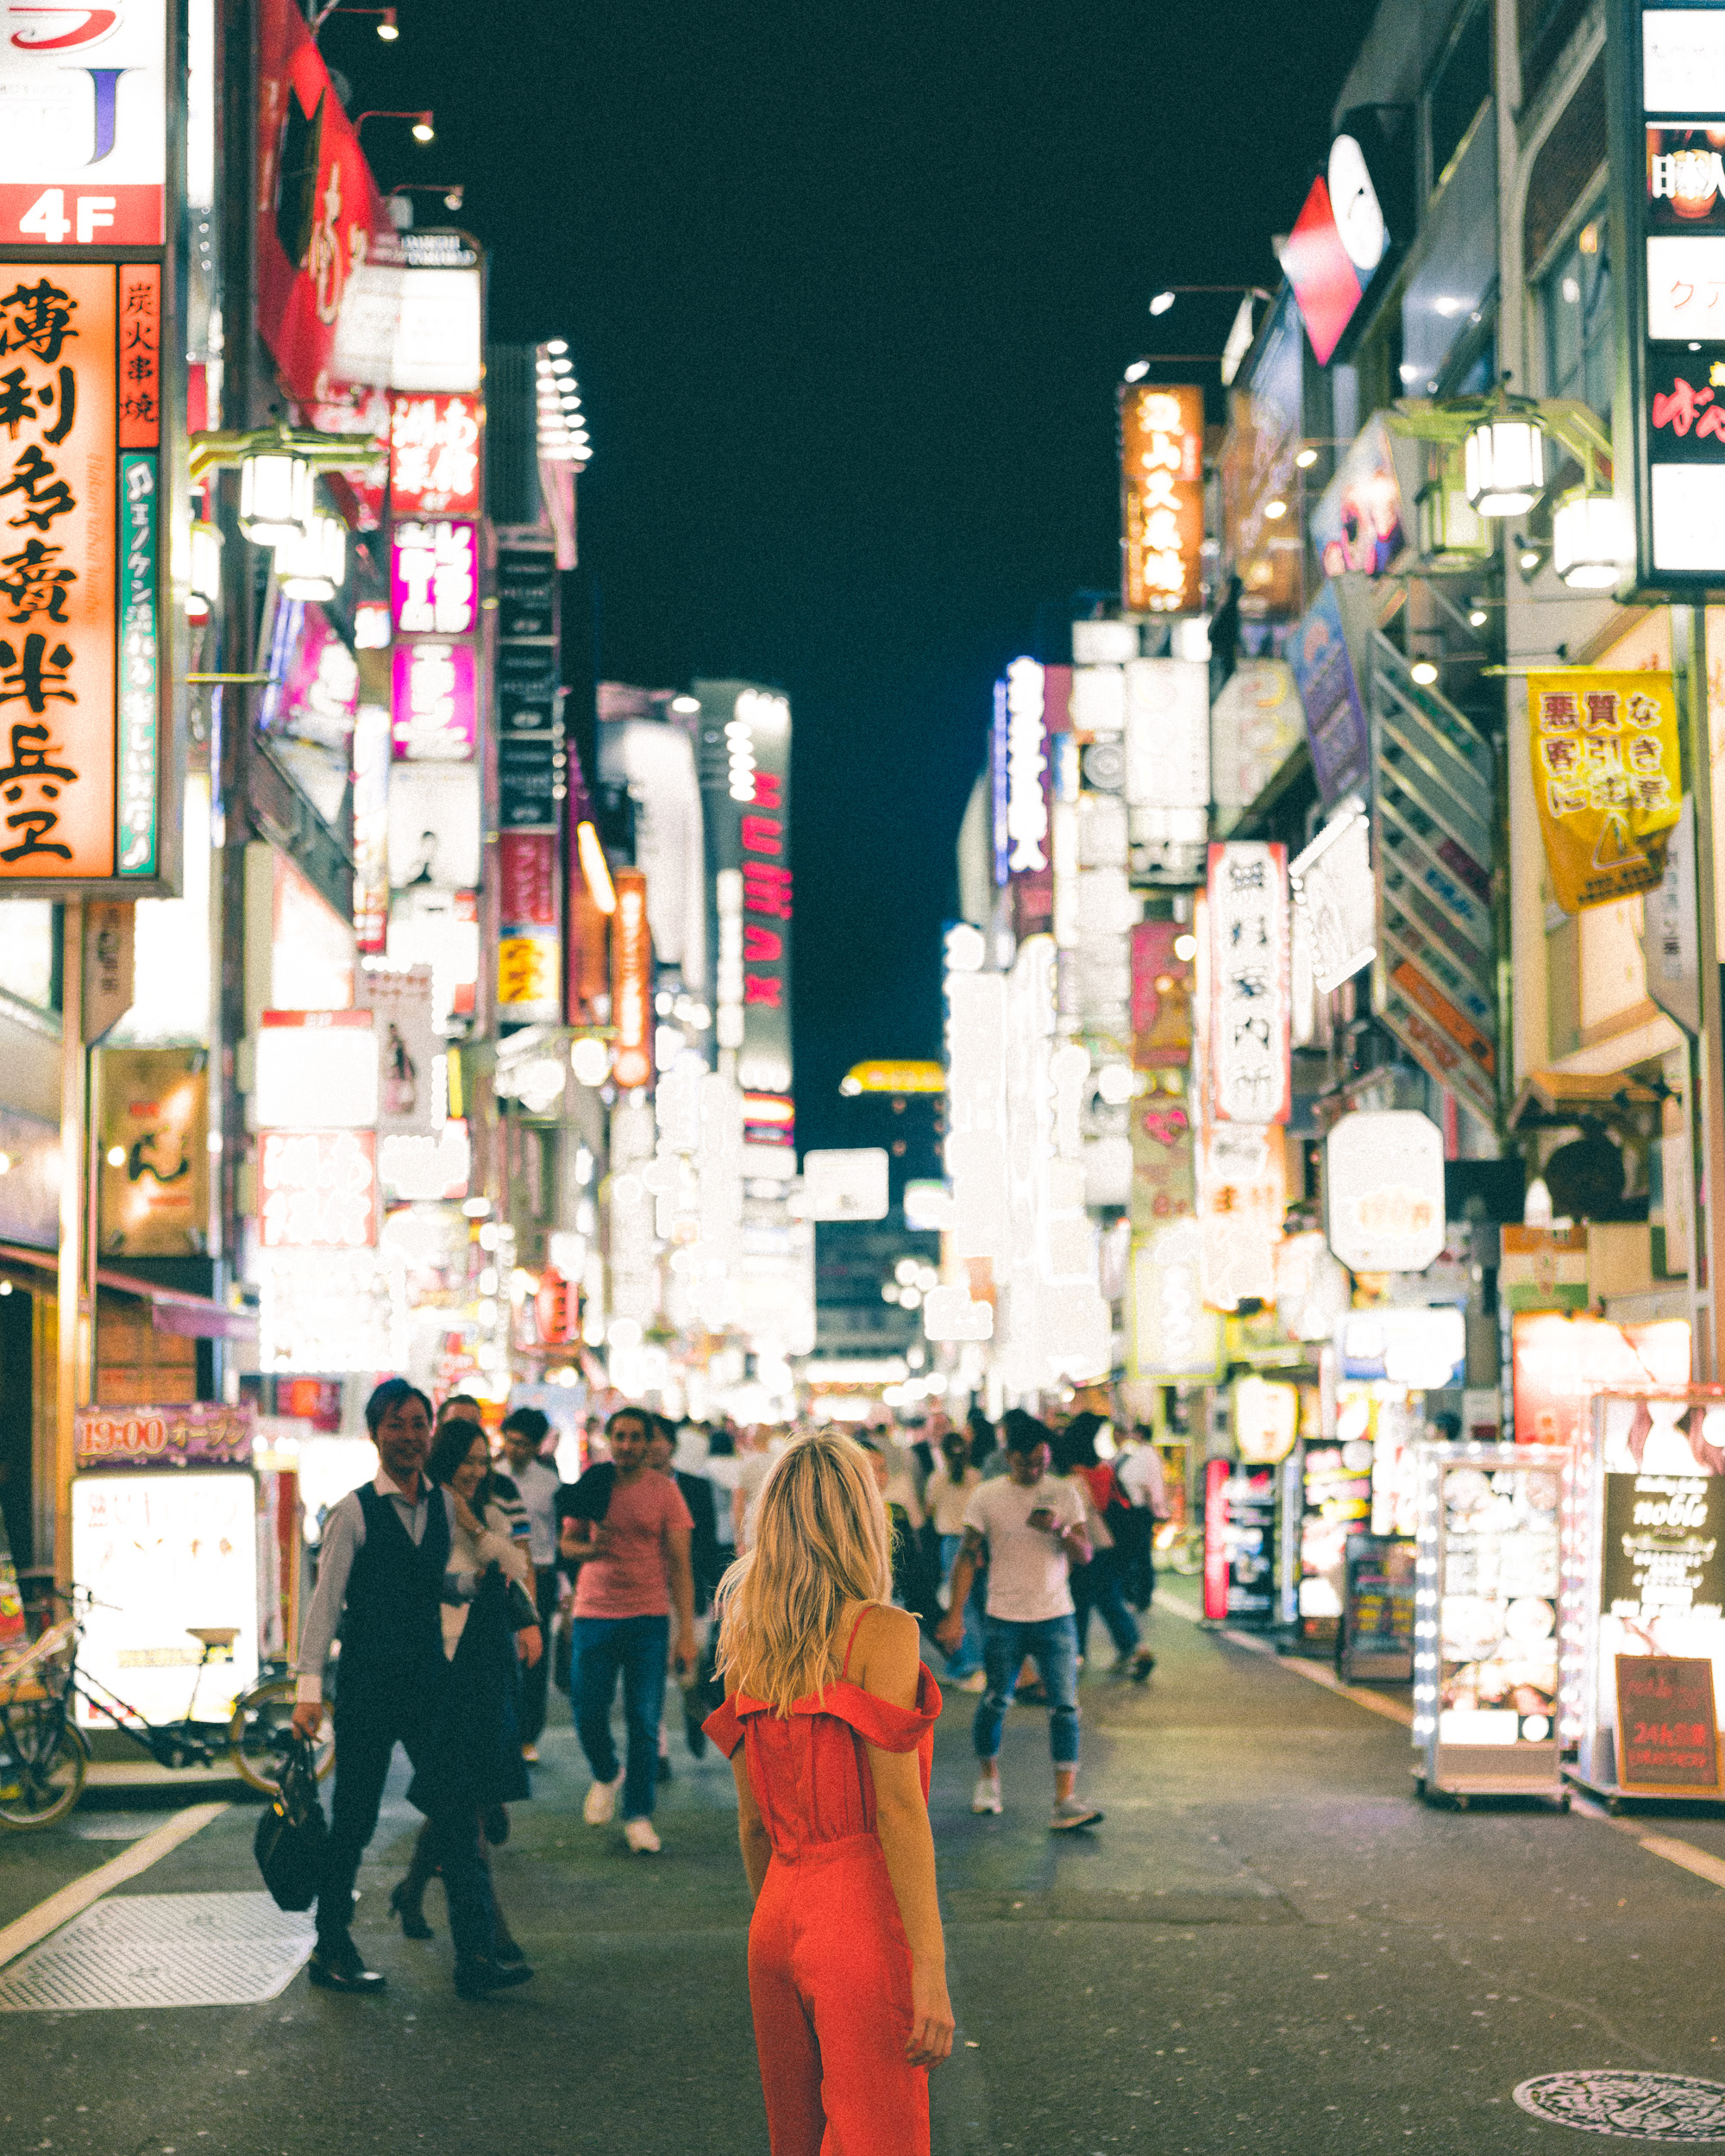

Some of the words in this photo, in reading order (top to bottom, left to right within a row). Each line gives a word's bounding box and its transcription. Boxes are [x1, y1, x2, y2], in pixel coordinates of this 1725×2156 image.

[19, 188, 116, 243] 4F
[1540, 692, 1661, 731] 悪質な
[1541, 736, 1662, 774] 客引き
[1547, 775, 1670, 816] に注意
[83, 1419, 167, 1453] 19:00
